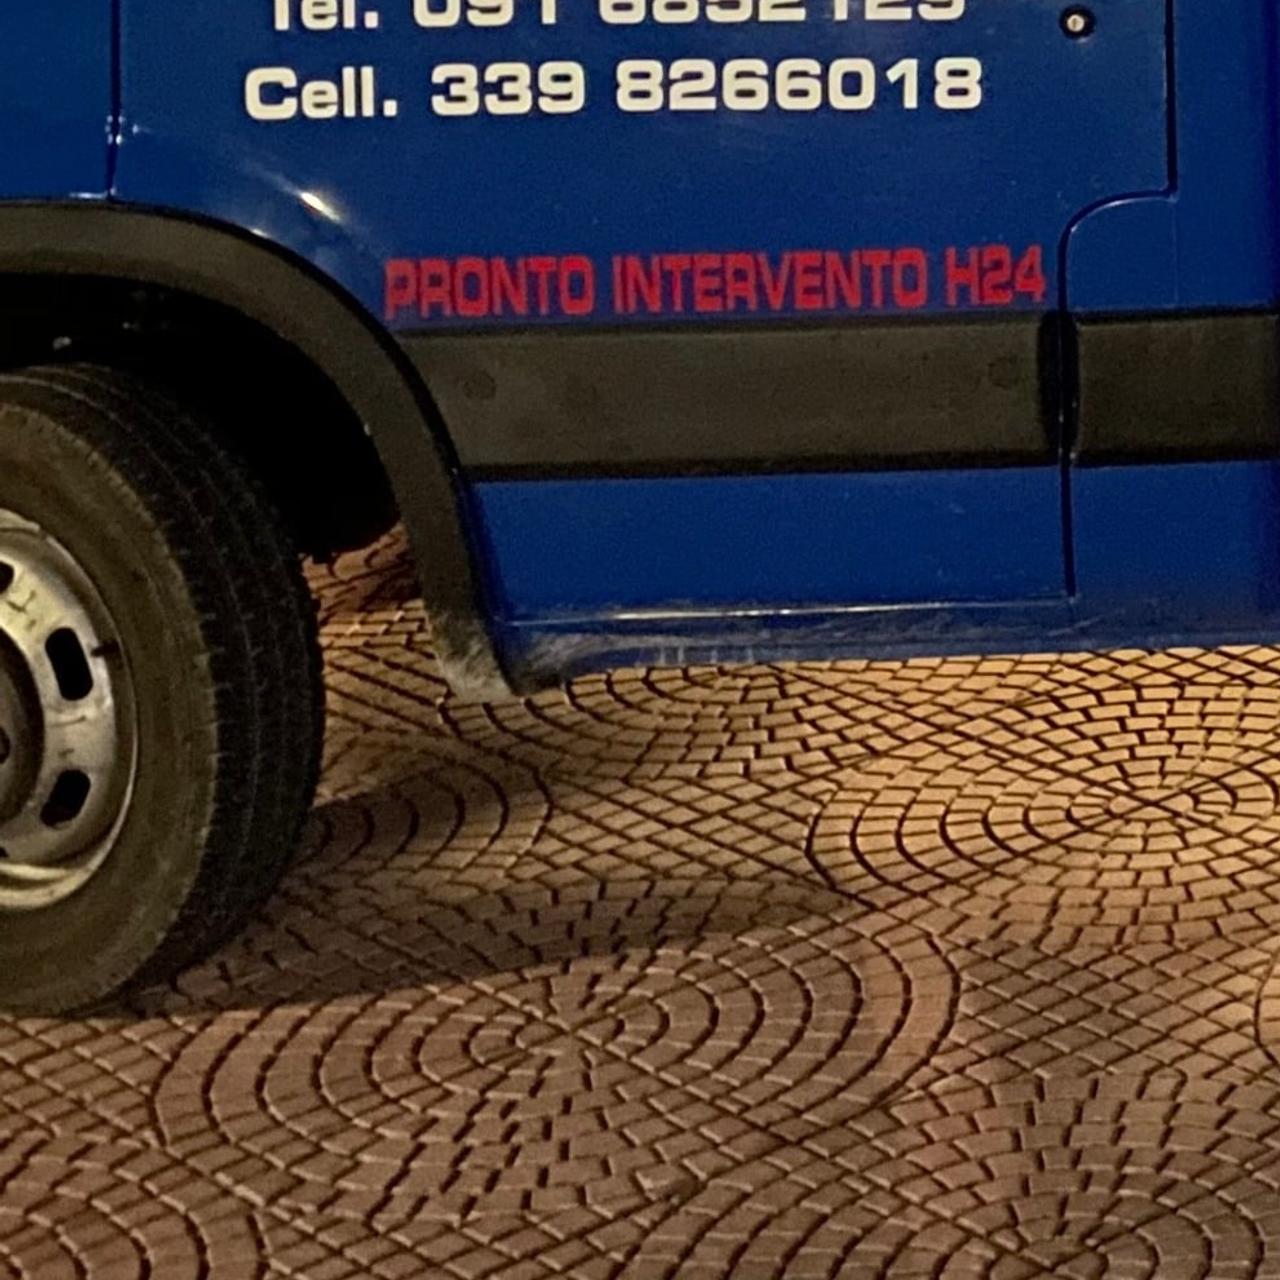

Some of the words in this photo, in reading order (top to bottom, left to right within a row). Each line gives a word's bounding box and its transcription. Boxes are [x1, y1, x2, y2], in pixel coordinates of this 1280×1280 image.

[245, 66, 397, 120] Cell.
[432, 61, 585, 115] 339
[617, 58, 982, 111] 8266018
[387, 256, 594, 316] PRONTO
[613, 248, 927, 312] INTERVENTO
[946, 245, 1045, 304] H24
